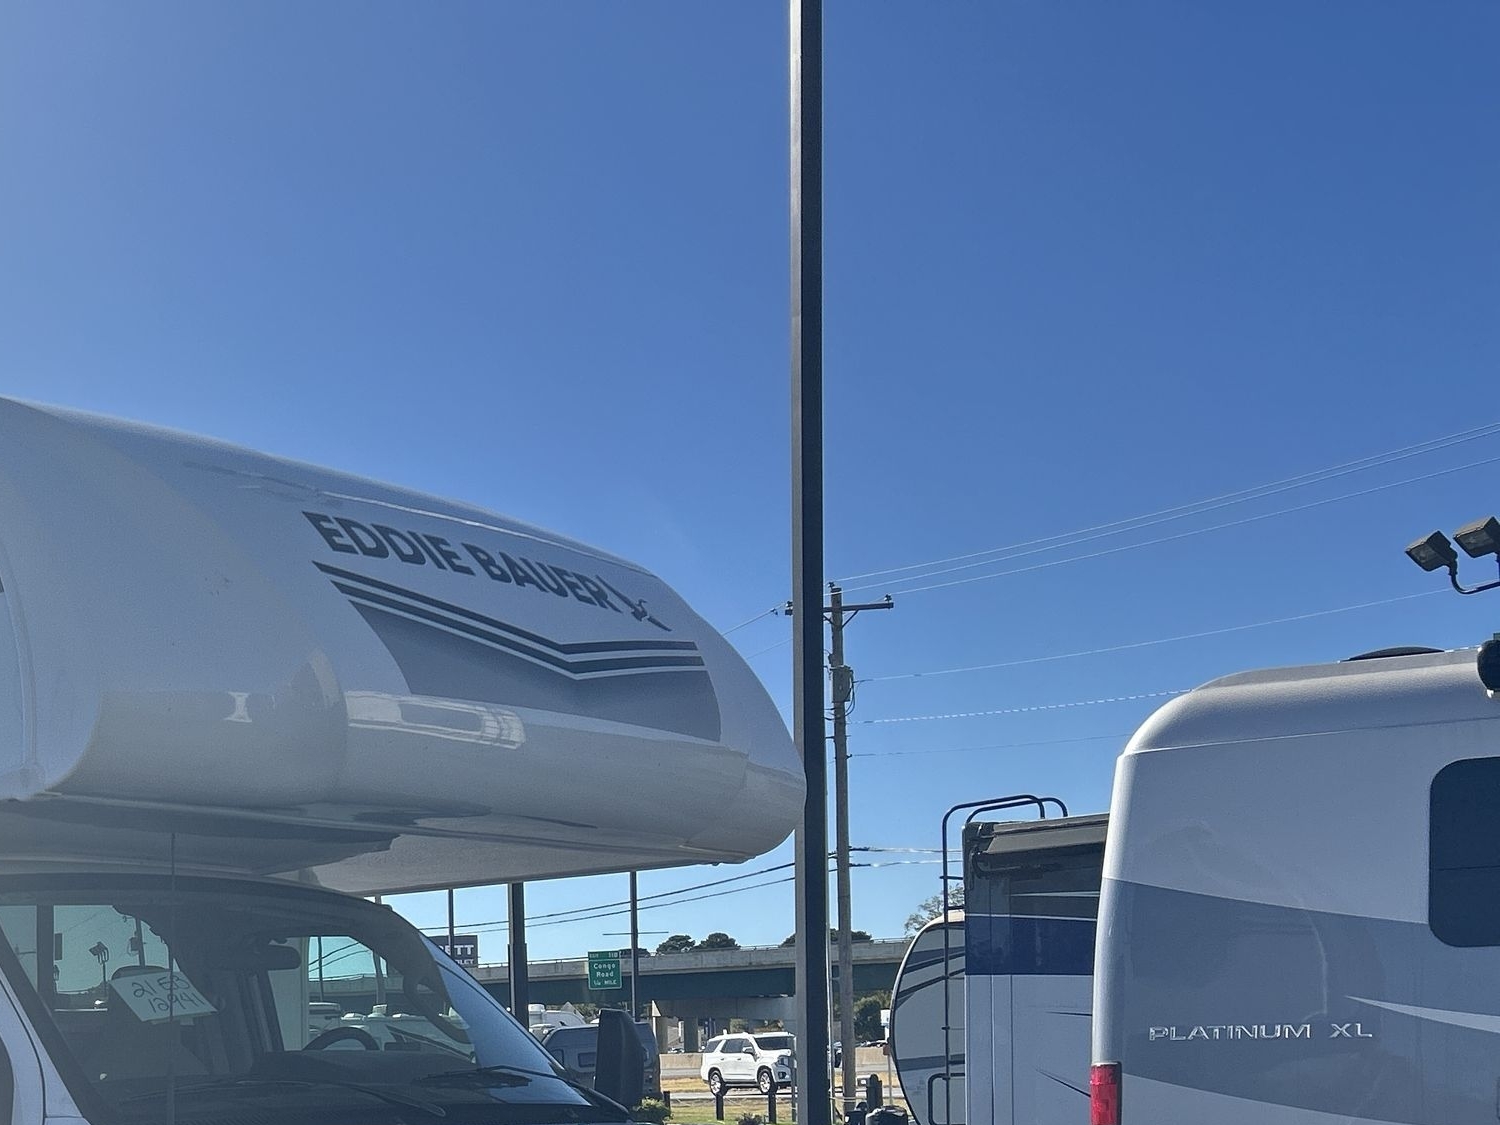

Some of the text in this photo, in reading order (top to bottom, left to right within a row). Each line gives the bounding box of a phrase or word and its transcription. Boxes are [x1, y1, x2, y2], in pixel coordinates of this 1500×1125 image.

[301, 510, 623, 614] EDDIE BAUER
[1149, 1023, 1373, 1041] PLATINUM XL
